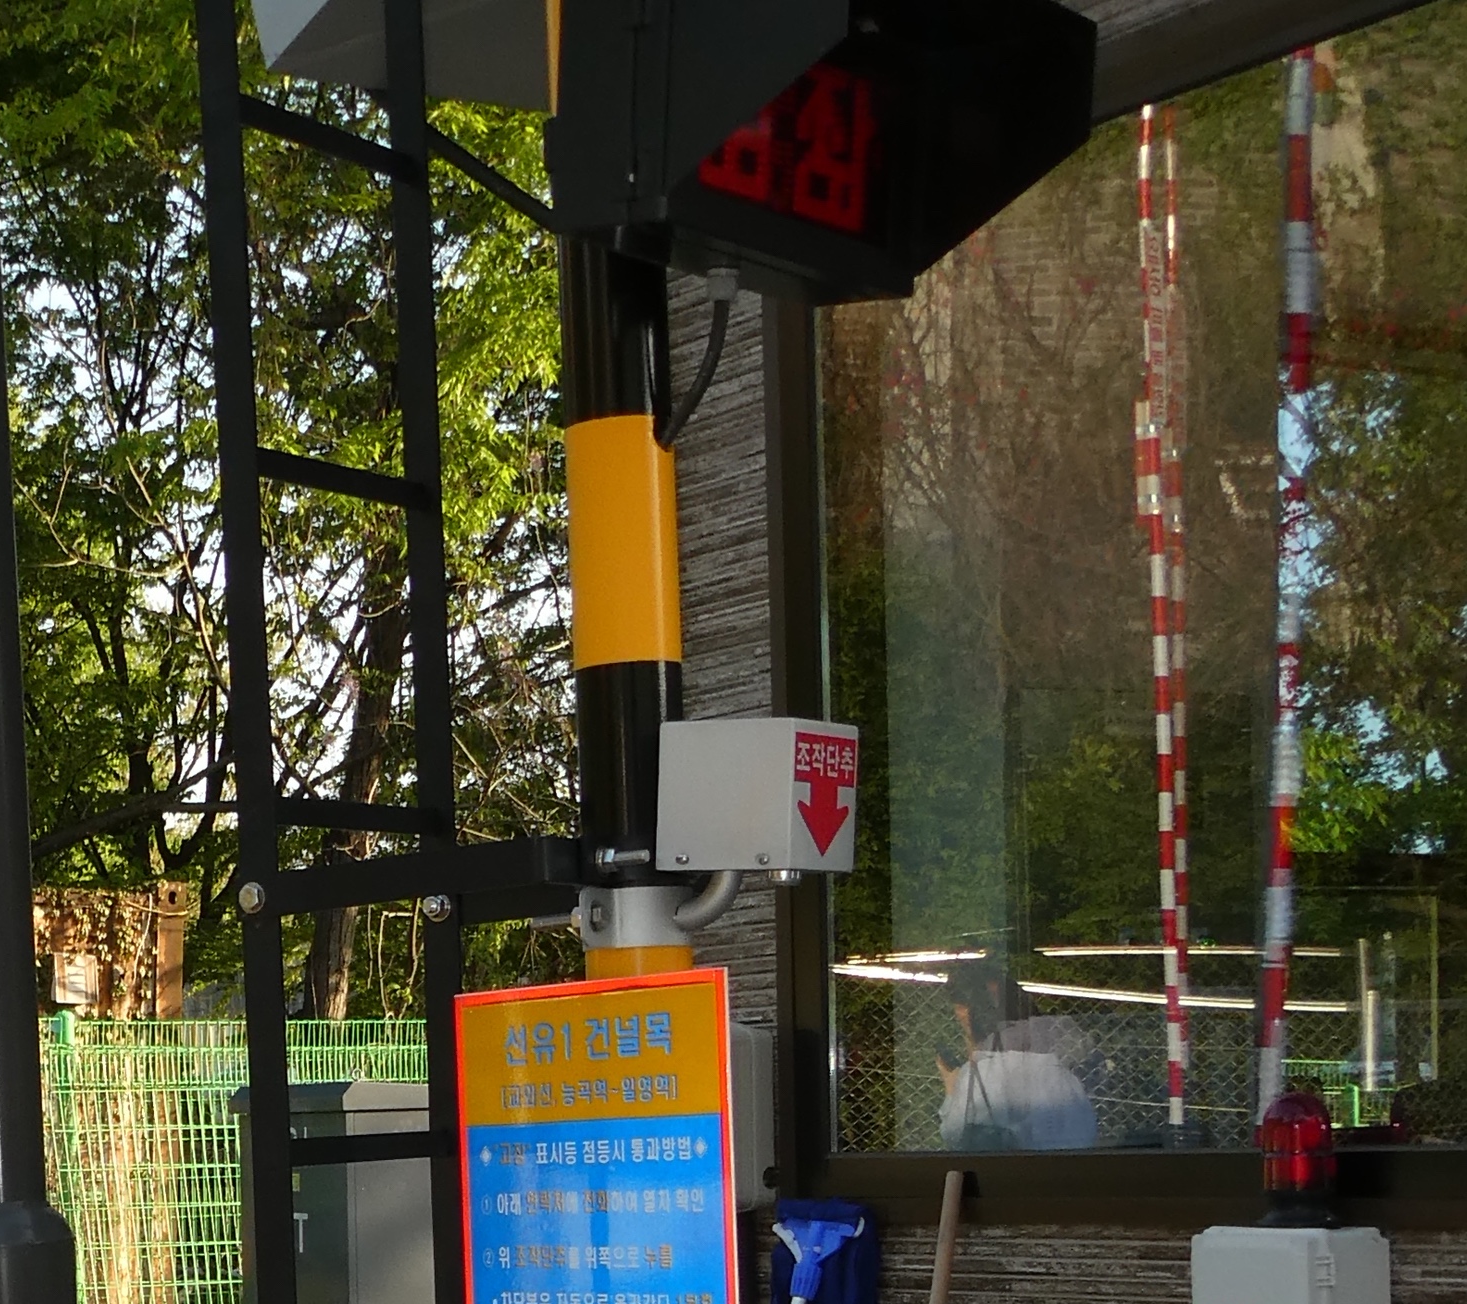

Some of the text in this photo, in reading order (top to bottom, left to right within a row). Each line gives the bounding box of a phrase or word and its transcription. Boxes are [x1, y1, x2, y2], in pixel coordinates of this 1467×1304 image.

[796, 742, 854, 780] 조작단추
[504, 1011, 672, 1067] 선유1 건널목
[535, 1141, 577, 1165] 표시등
[582, 1139, 625, 1164] 점등시
[631, 1136, 693, 1163] 통과방법
[497, 1192, 522, 1216] 아래
[643, 1189, 670, 1213] 열차
[675, 1188, 705, 1212] 확인
[499, 1246, 511, 1269] 위
[585, 1246, 640, 1269] 위쪽으로
[644, 1244, 673, 1269] 누름
